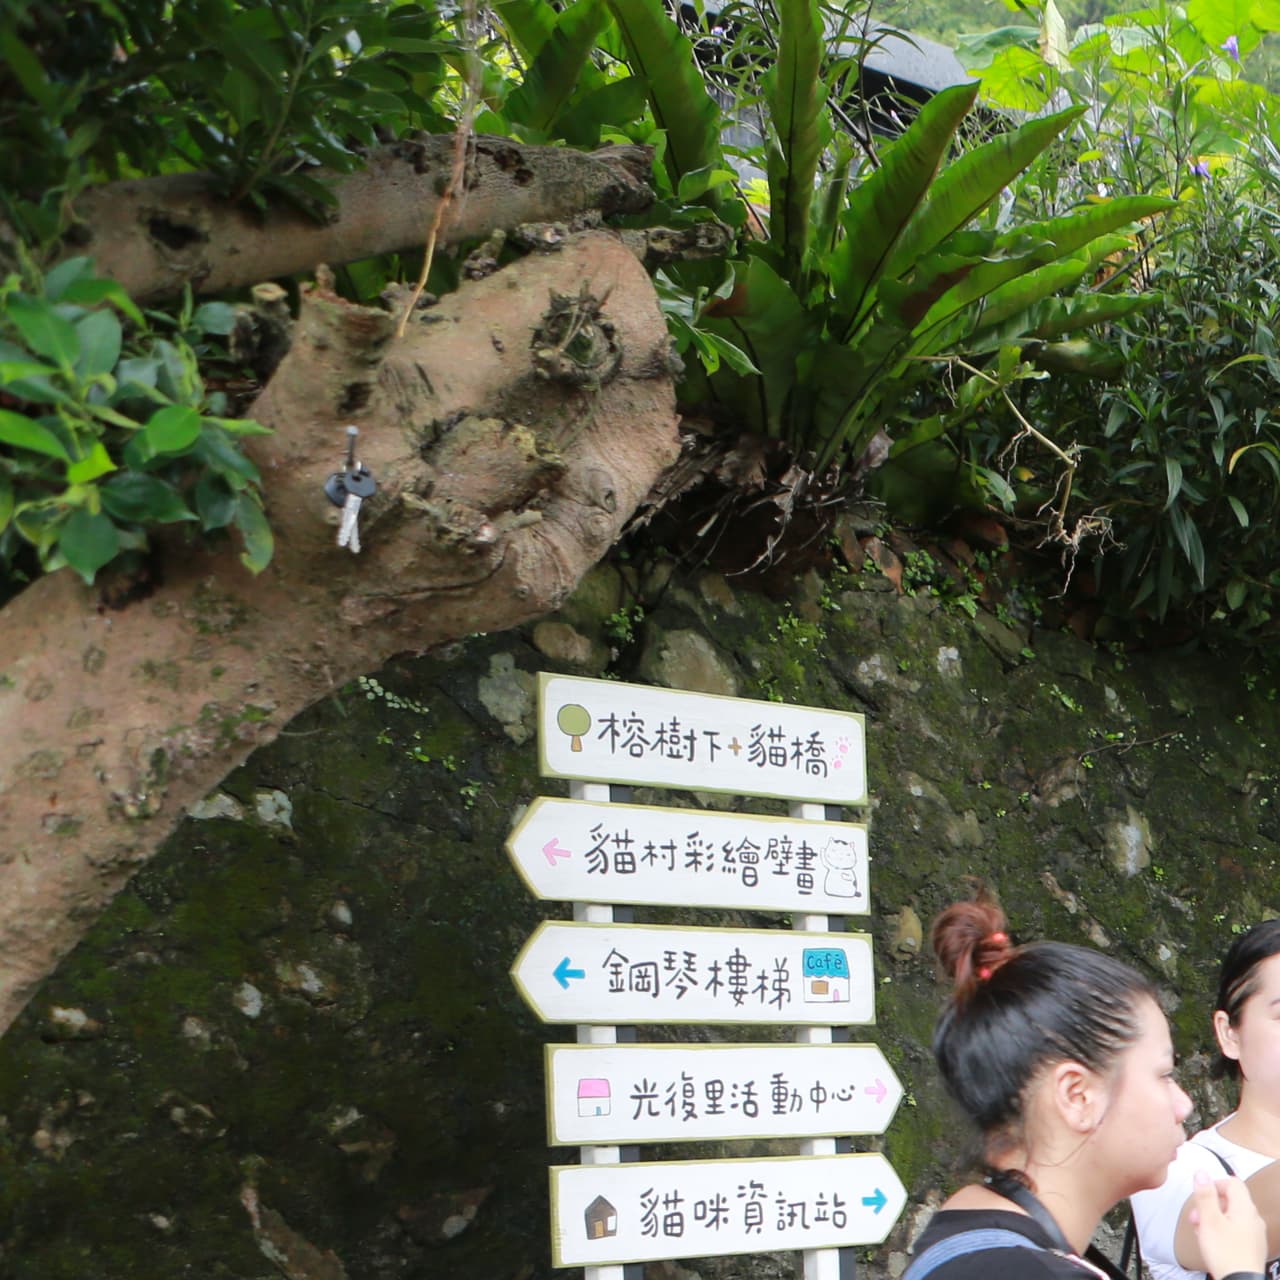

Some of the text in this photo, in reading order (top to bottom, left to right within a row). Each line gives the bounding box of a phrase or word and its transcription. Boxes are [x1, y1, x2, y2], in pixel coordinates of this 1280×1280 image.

[584, 823, 819, 895] 貓村彩繪壁畫
[602, 947, 792, 1011] 鋼琴樓梯
[630, 1071, 856, 1122] 光復里活動中心
[639, 1179, 848, 1238] 貓咪資訊站
